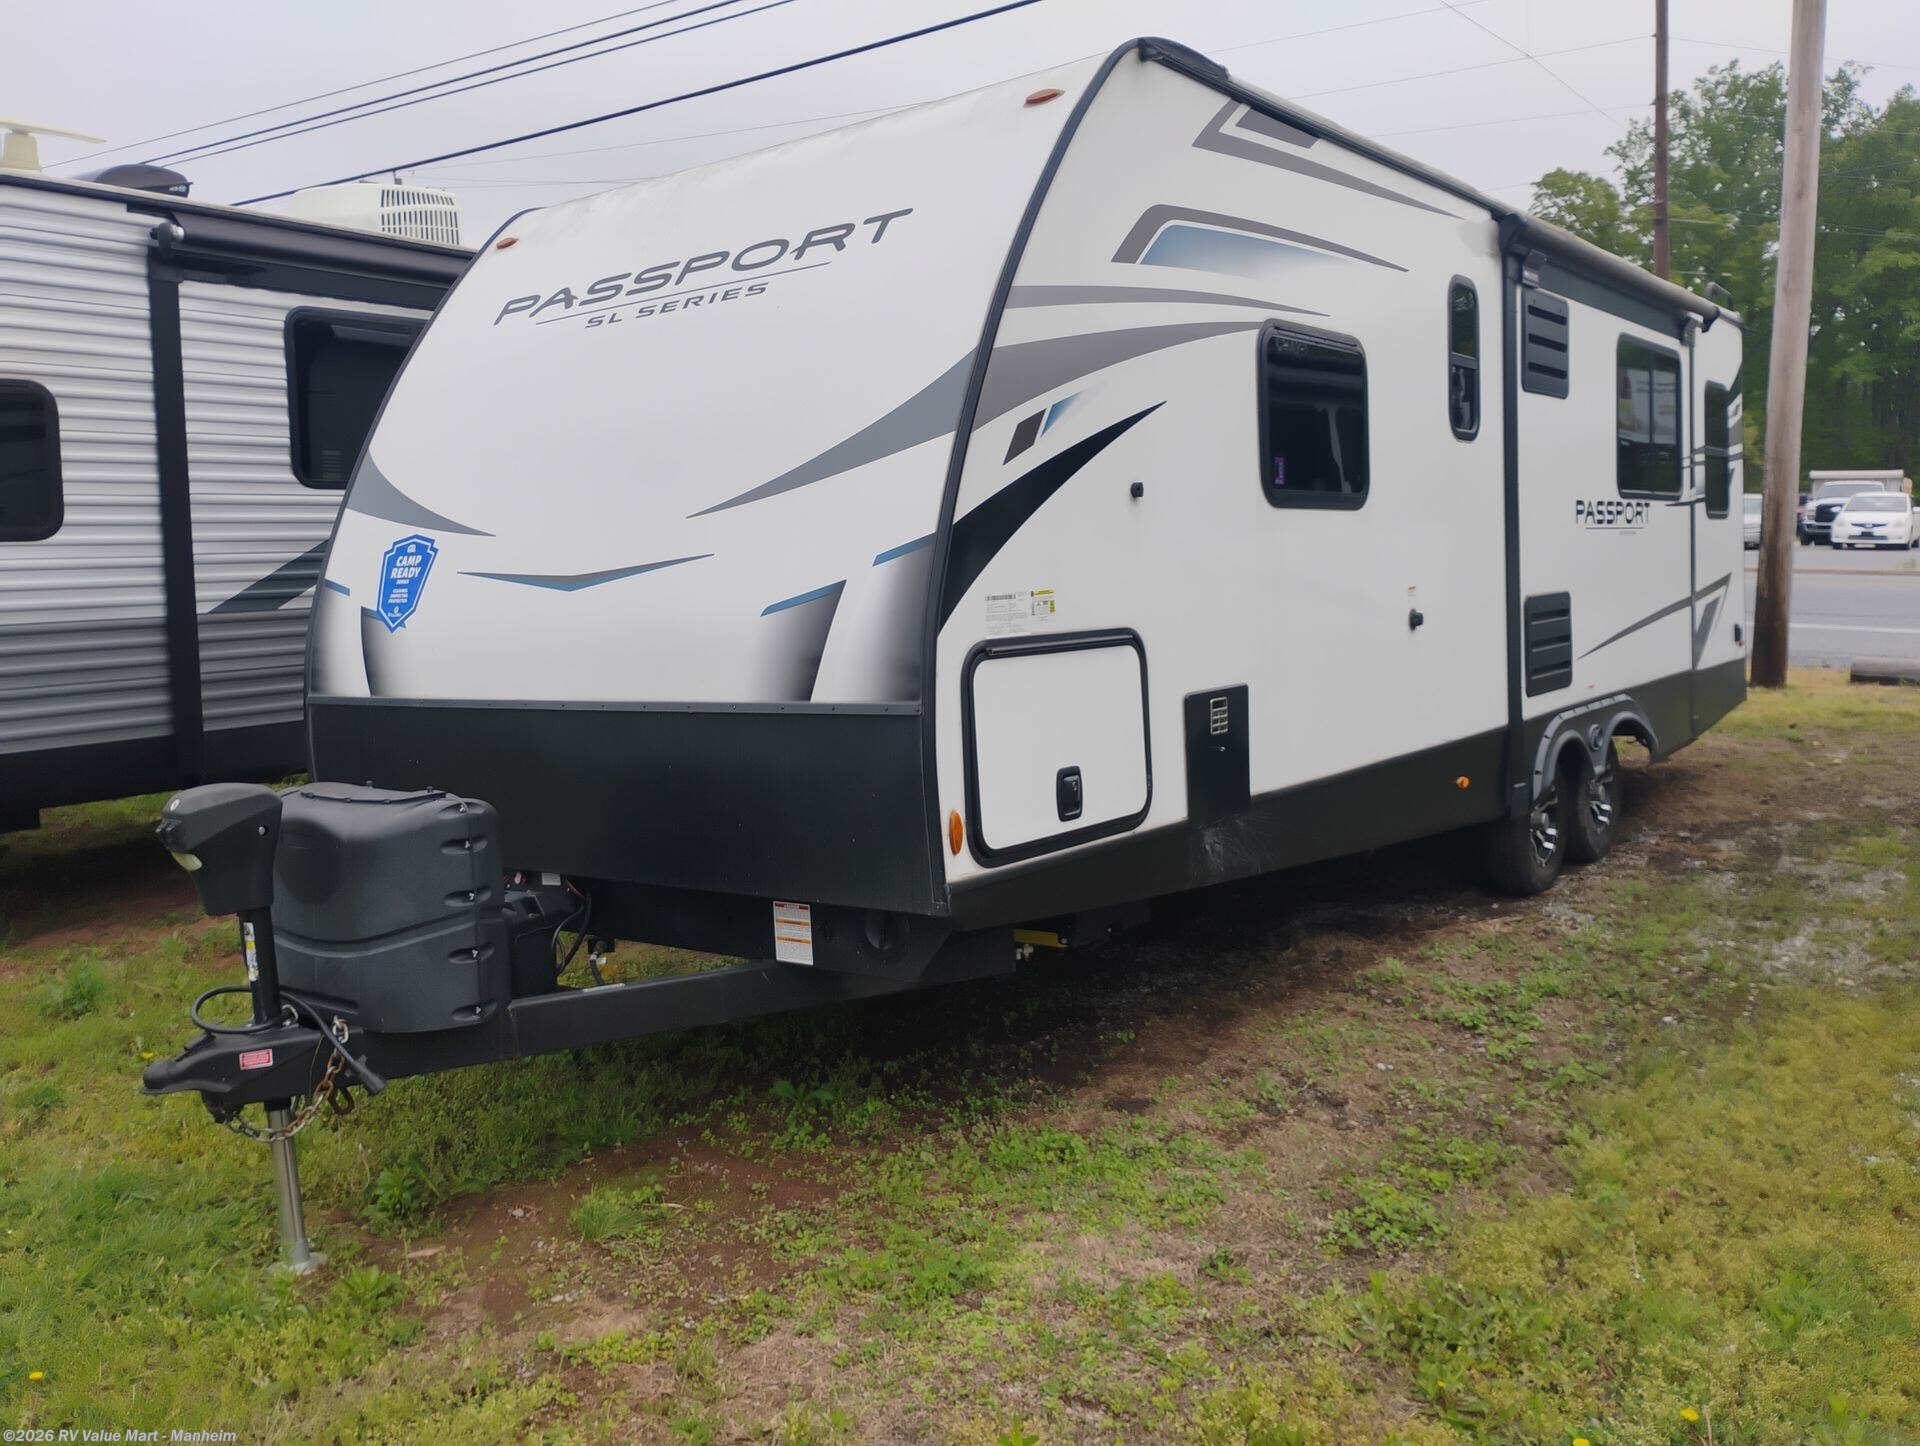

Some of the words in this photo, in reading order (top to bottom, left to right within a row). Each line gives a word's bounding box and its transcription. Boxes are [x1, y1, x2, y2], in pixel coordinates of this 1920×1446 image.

[494, 207, 914, 326] PASSPORT
[585, 312, 623, 329] SL
[636, 282, 769, 319] SERIES
[1576, 499, 1650, 524] PASSPORT
[390, 566, 422, 579] READY
[396, 555, 422, 567] CAMP
